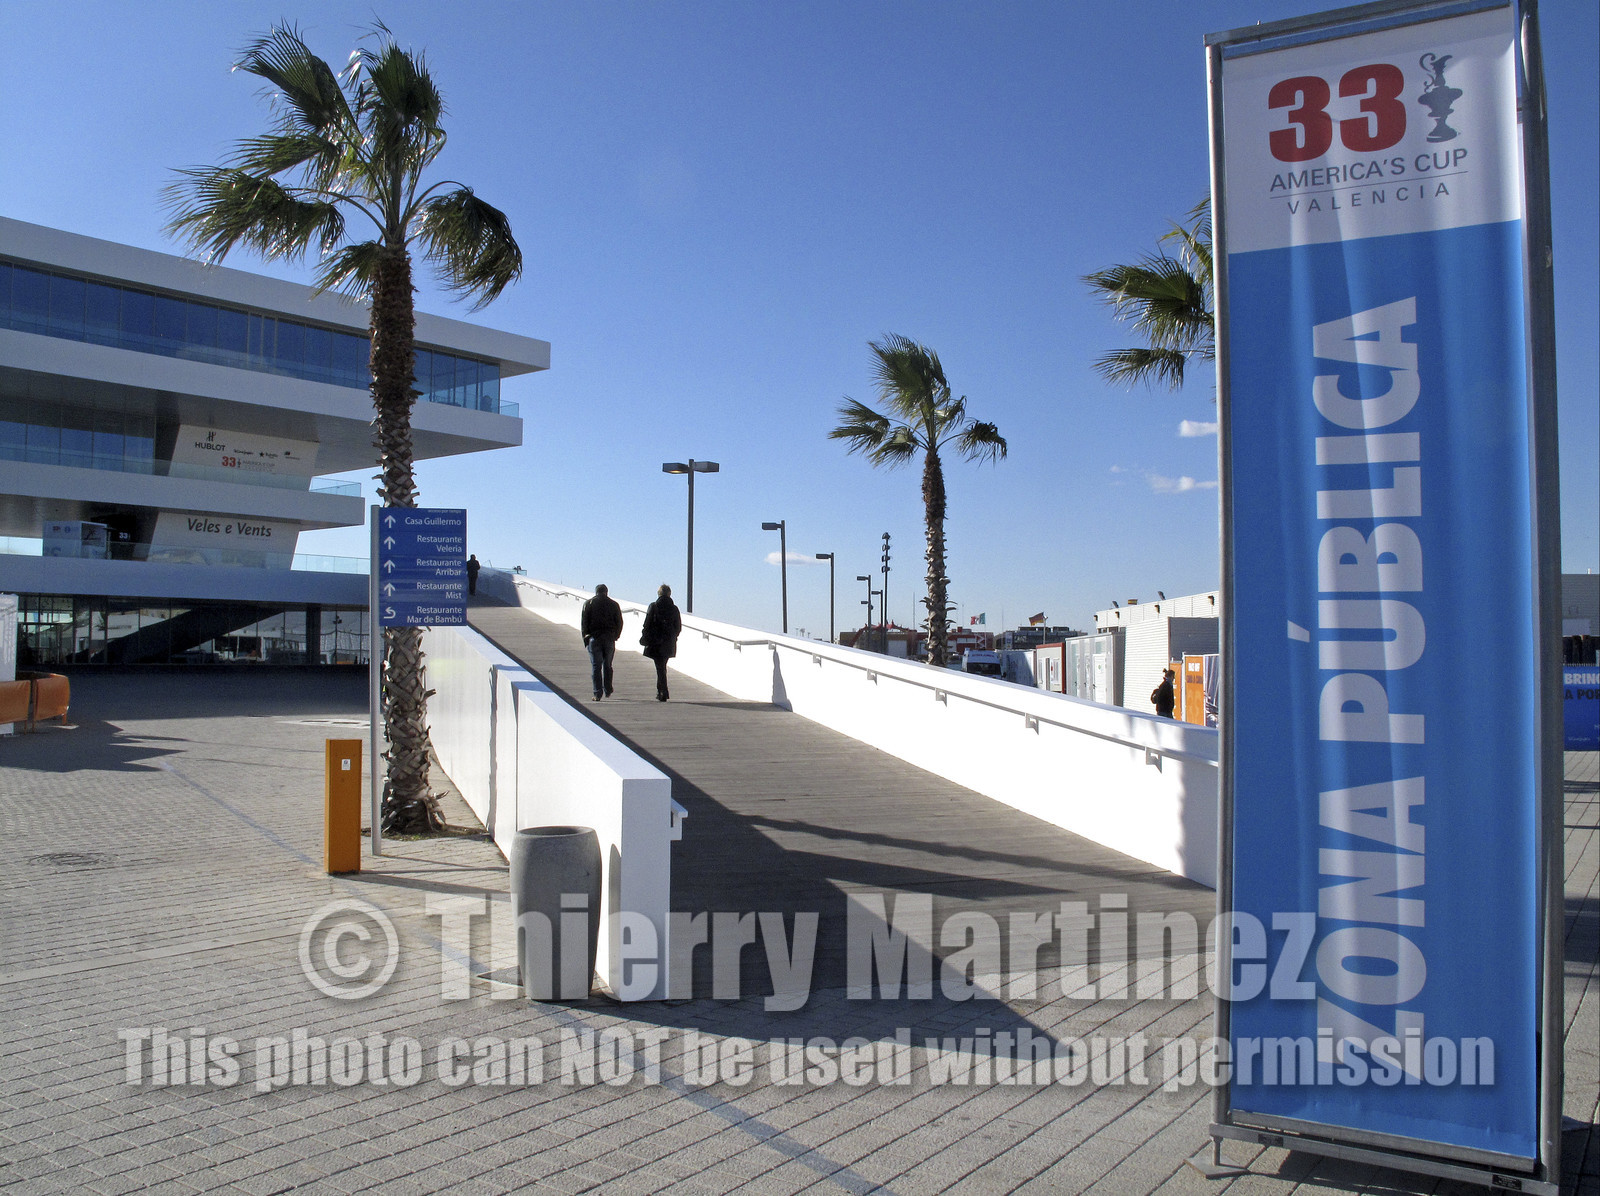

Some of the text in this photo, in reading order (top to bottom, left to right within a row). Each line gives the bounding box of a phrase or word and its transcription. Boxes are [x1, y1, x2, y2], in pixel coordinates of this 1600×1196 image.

[1268, 63, 1407, 162] 33
[1270, 148, 1468, 192] AMERICA'S CUP
[1287, 182, 1449, 215] VALENCIA
[195, 442, 226, 451] HUBLOT
[222, 456, 236, 467] 33
[405, 517, 462, 526] Casa Guillermo
[188, 518, 271, 537] Veles e Vents
[417, 535, 462, 543] Restaurante
[436, 545, 462, 553] Veleria
[416, 559, 462, 567] Restaurante
[435, 568, 462, 576] Arribar
[416, 582, 462, 590] Restaurante
[417, 606, 462, 614] Restaurante
[424, 615, 433, 623] de
[435, 615, 462, 623] Bambú
[1564, 673, 1600, 685] BRIN
[1287, 296, 1427, 1081] ZONA PÚBLICA
